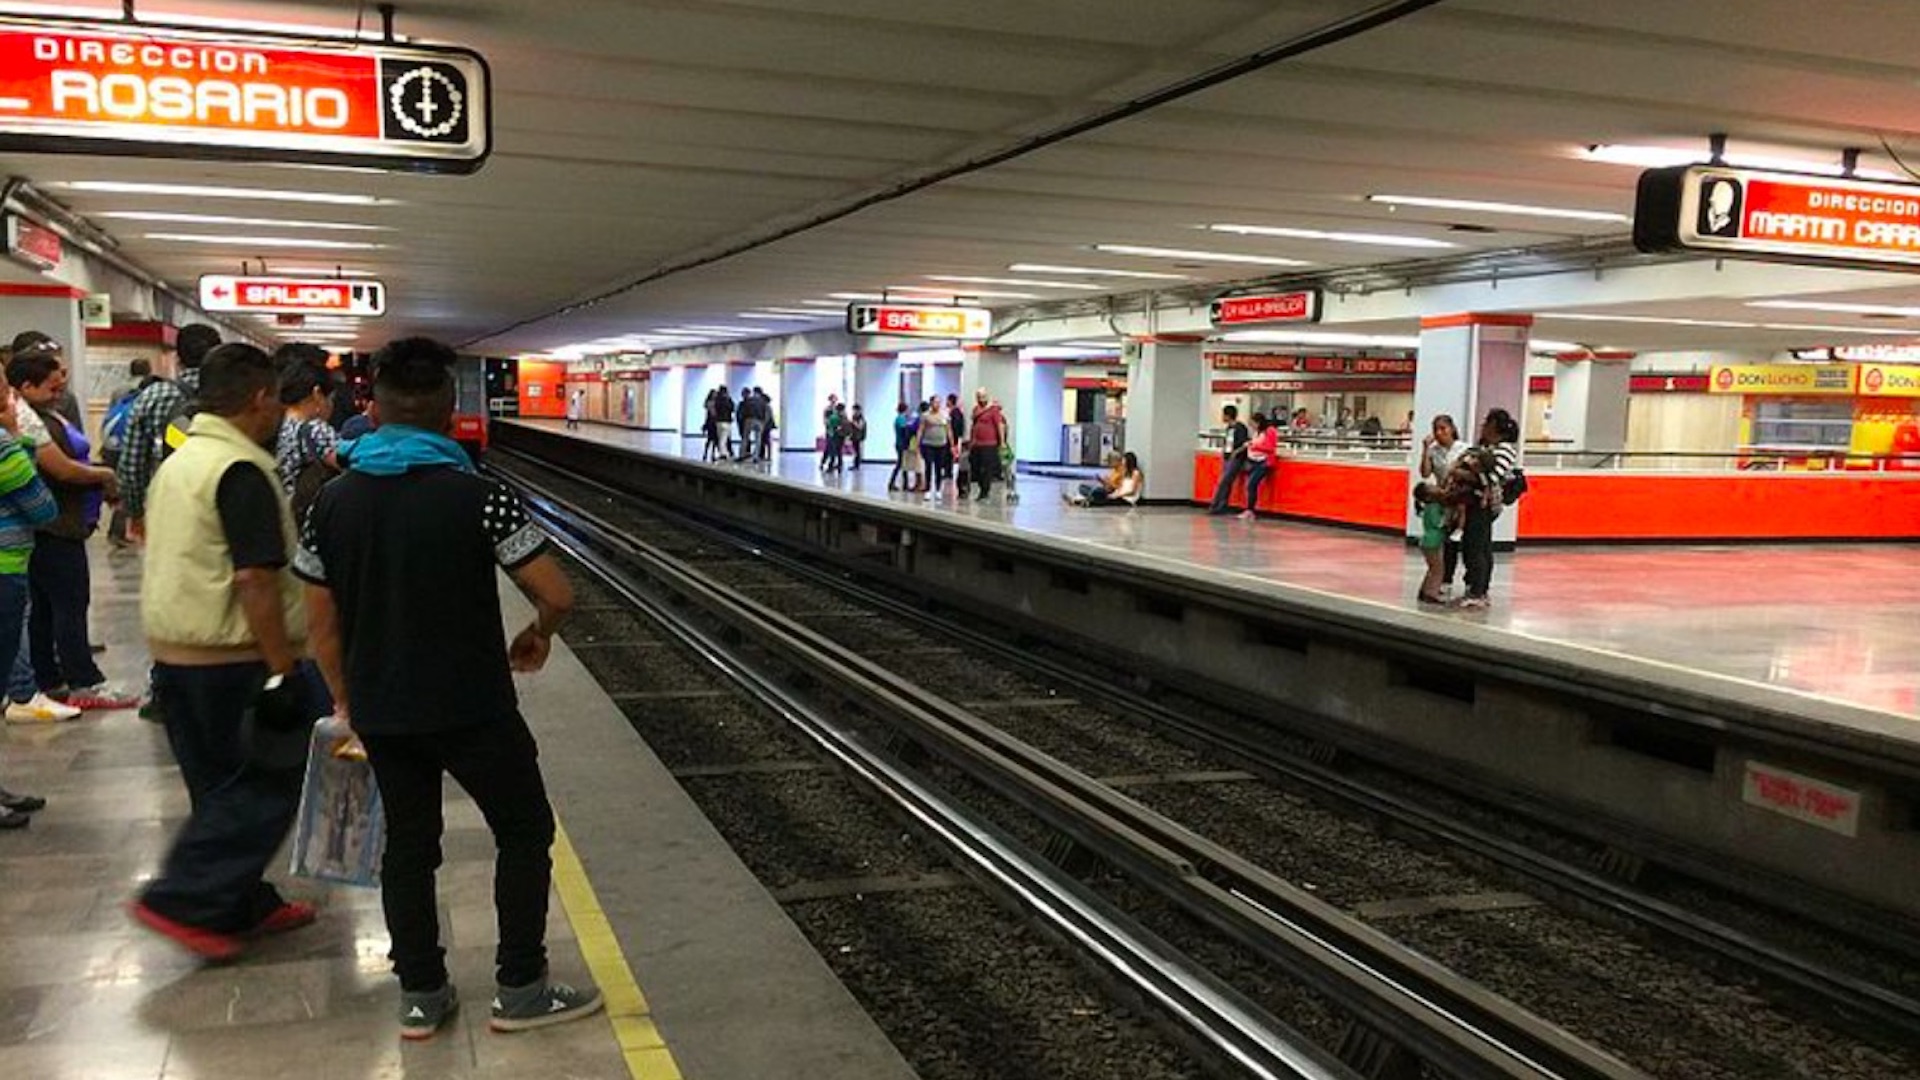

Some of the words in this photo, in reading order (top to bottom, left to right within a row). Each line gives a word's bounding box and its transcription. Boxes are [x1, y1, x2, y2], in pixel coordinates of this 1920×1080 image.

[34, 38, 268, 74] DIRECCION
[51, 70, 350, 128] ROSARIO
[1808, 191, 1920, 216] DIRECCION
[1749, 211, 1846, 240] MARTIN
[246, 286, 341, 306] SALIDA
[887, 312, 959, 330] SALIDA
[1738, 374, 1764, 385] DON
[1767, 374, 1808, 385] LUCHO
